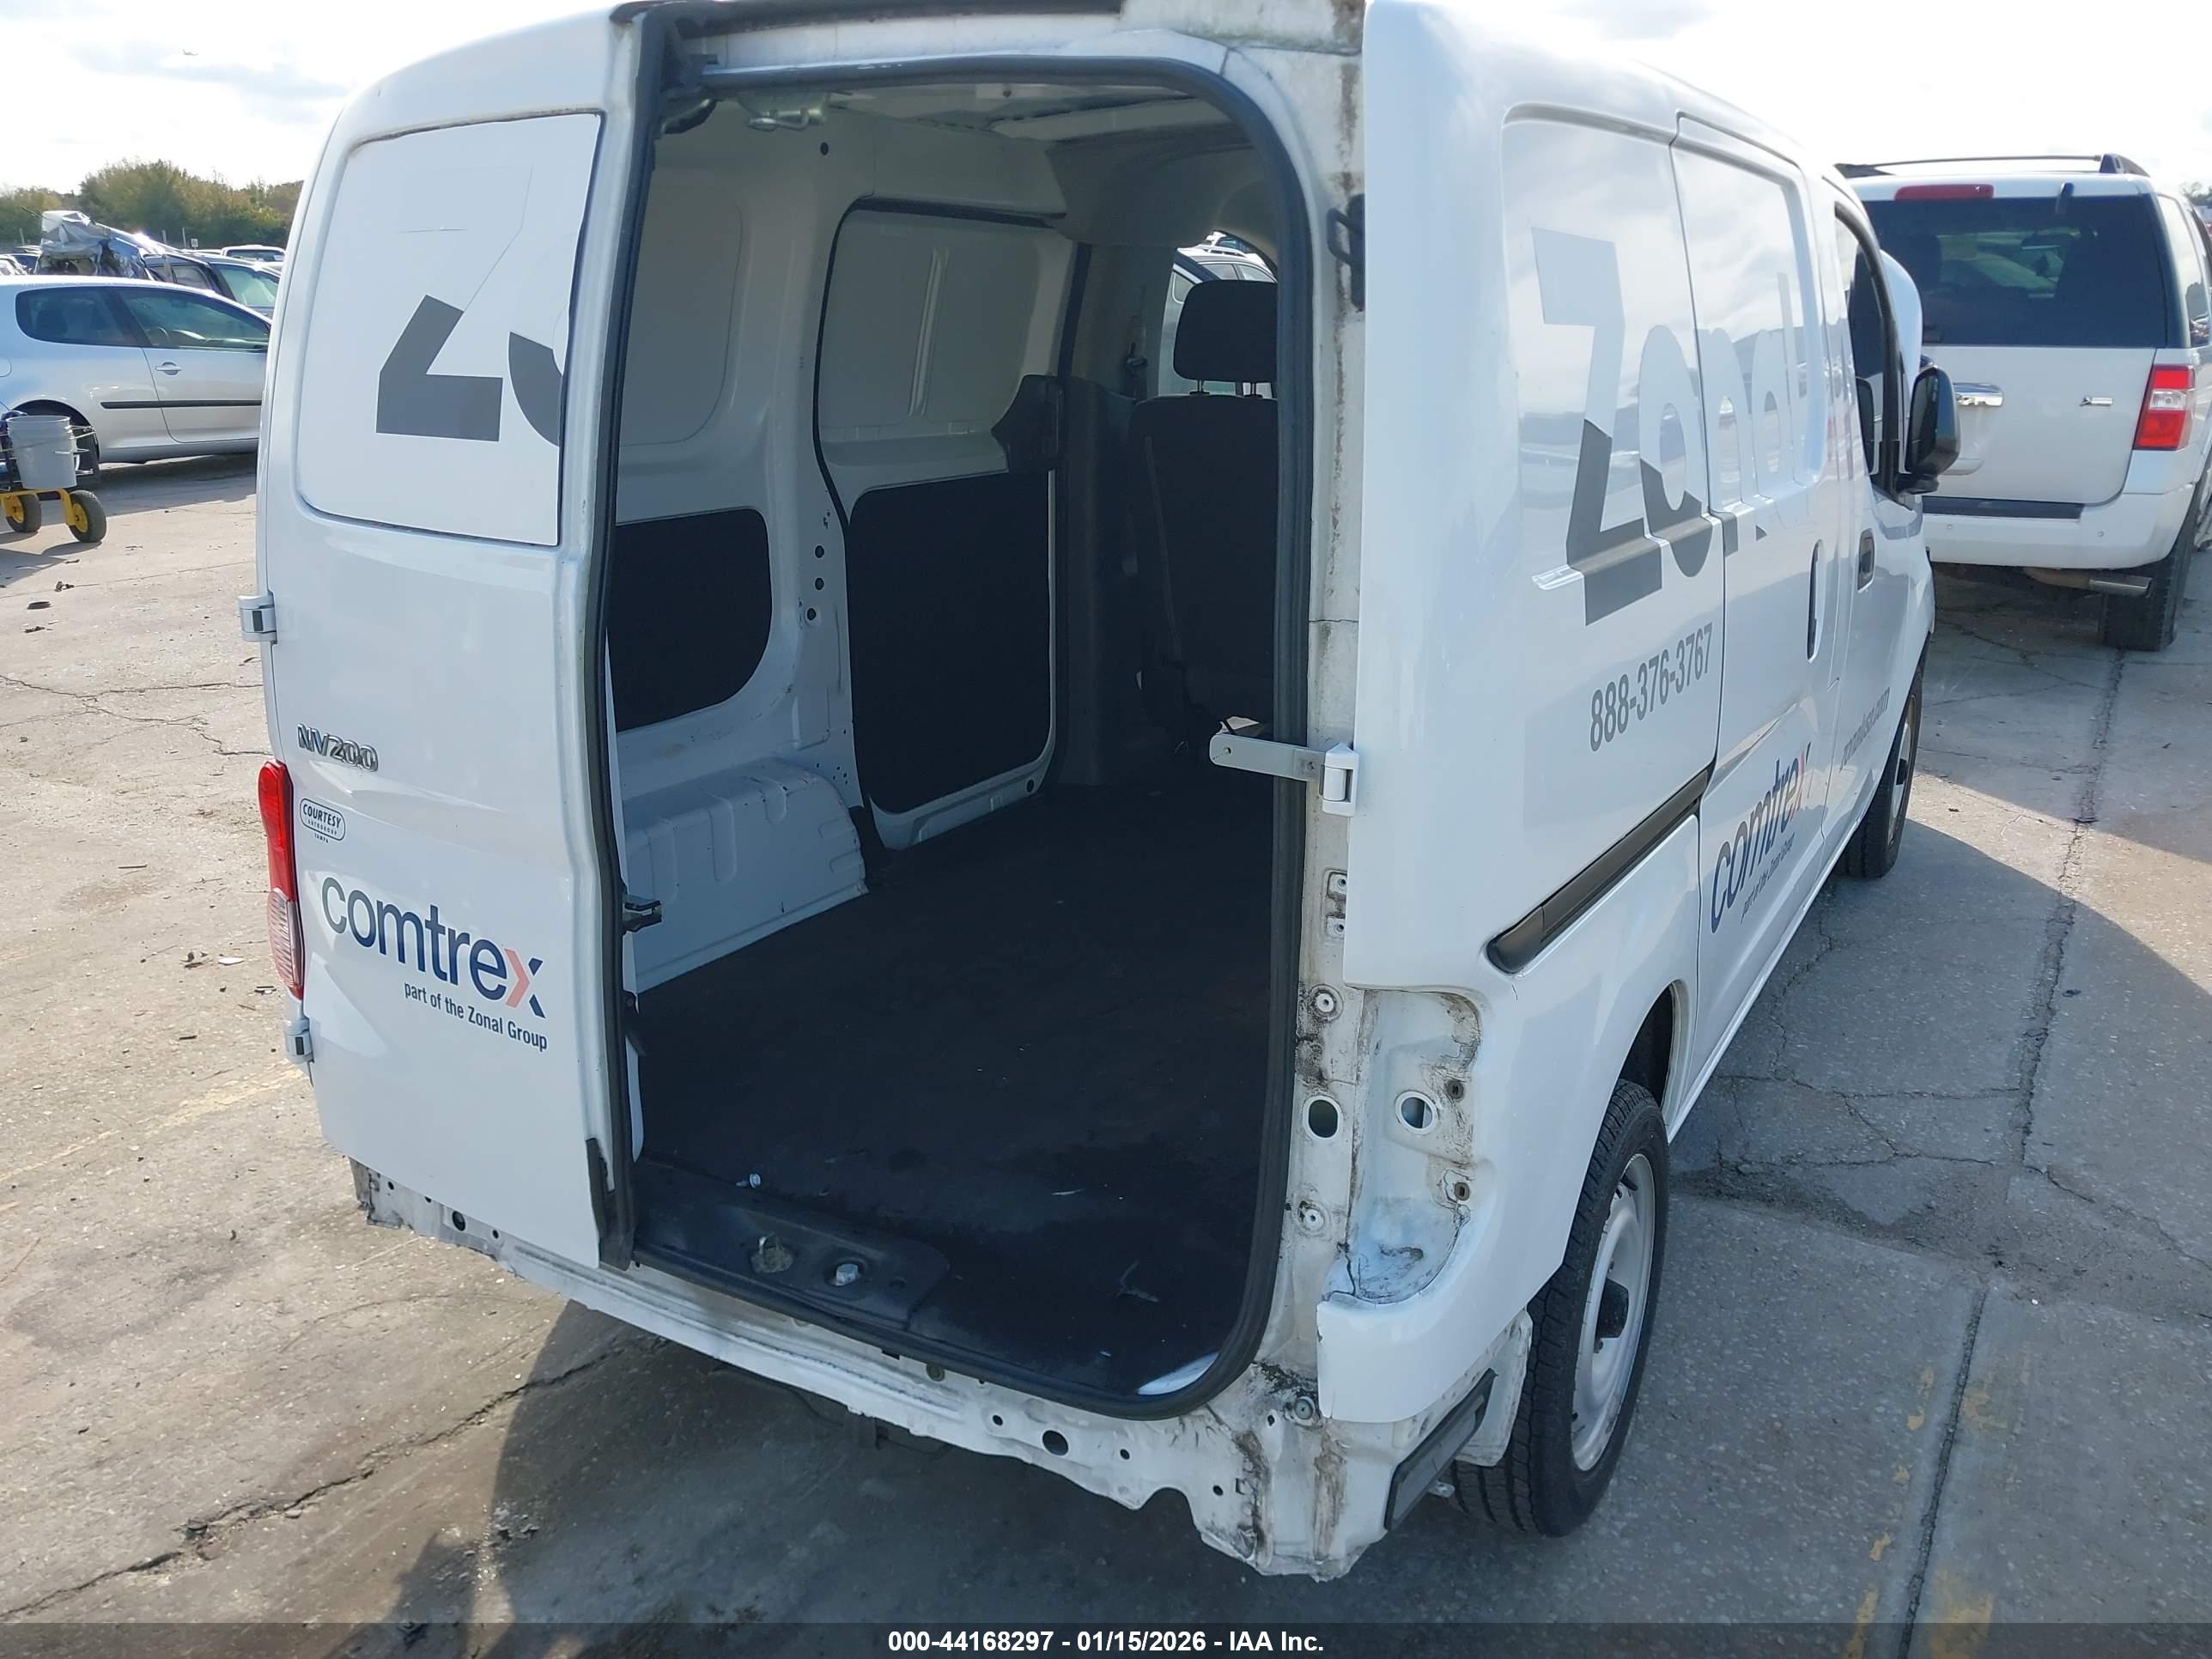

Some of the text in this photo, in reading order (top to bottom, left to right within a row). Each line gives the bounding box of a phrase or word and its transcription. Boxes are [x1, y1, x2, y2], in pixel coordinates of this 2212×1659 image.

[1590, 622, 1712, 751] 888-376-3767
[297, 723, 378, 772] NV200
[303, 804, 341, 828] COURTESY
[1711, 741, 1811, 933] comtrex
[322, 877, 546, 1018] comtrex
[404, 982, 547, 1052] part of the Zonal Group
